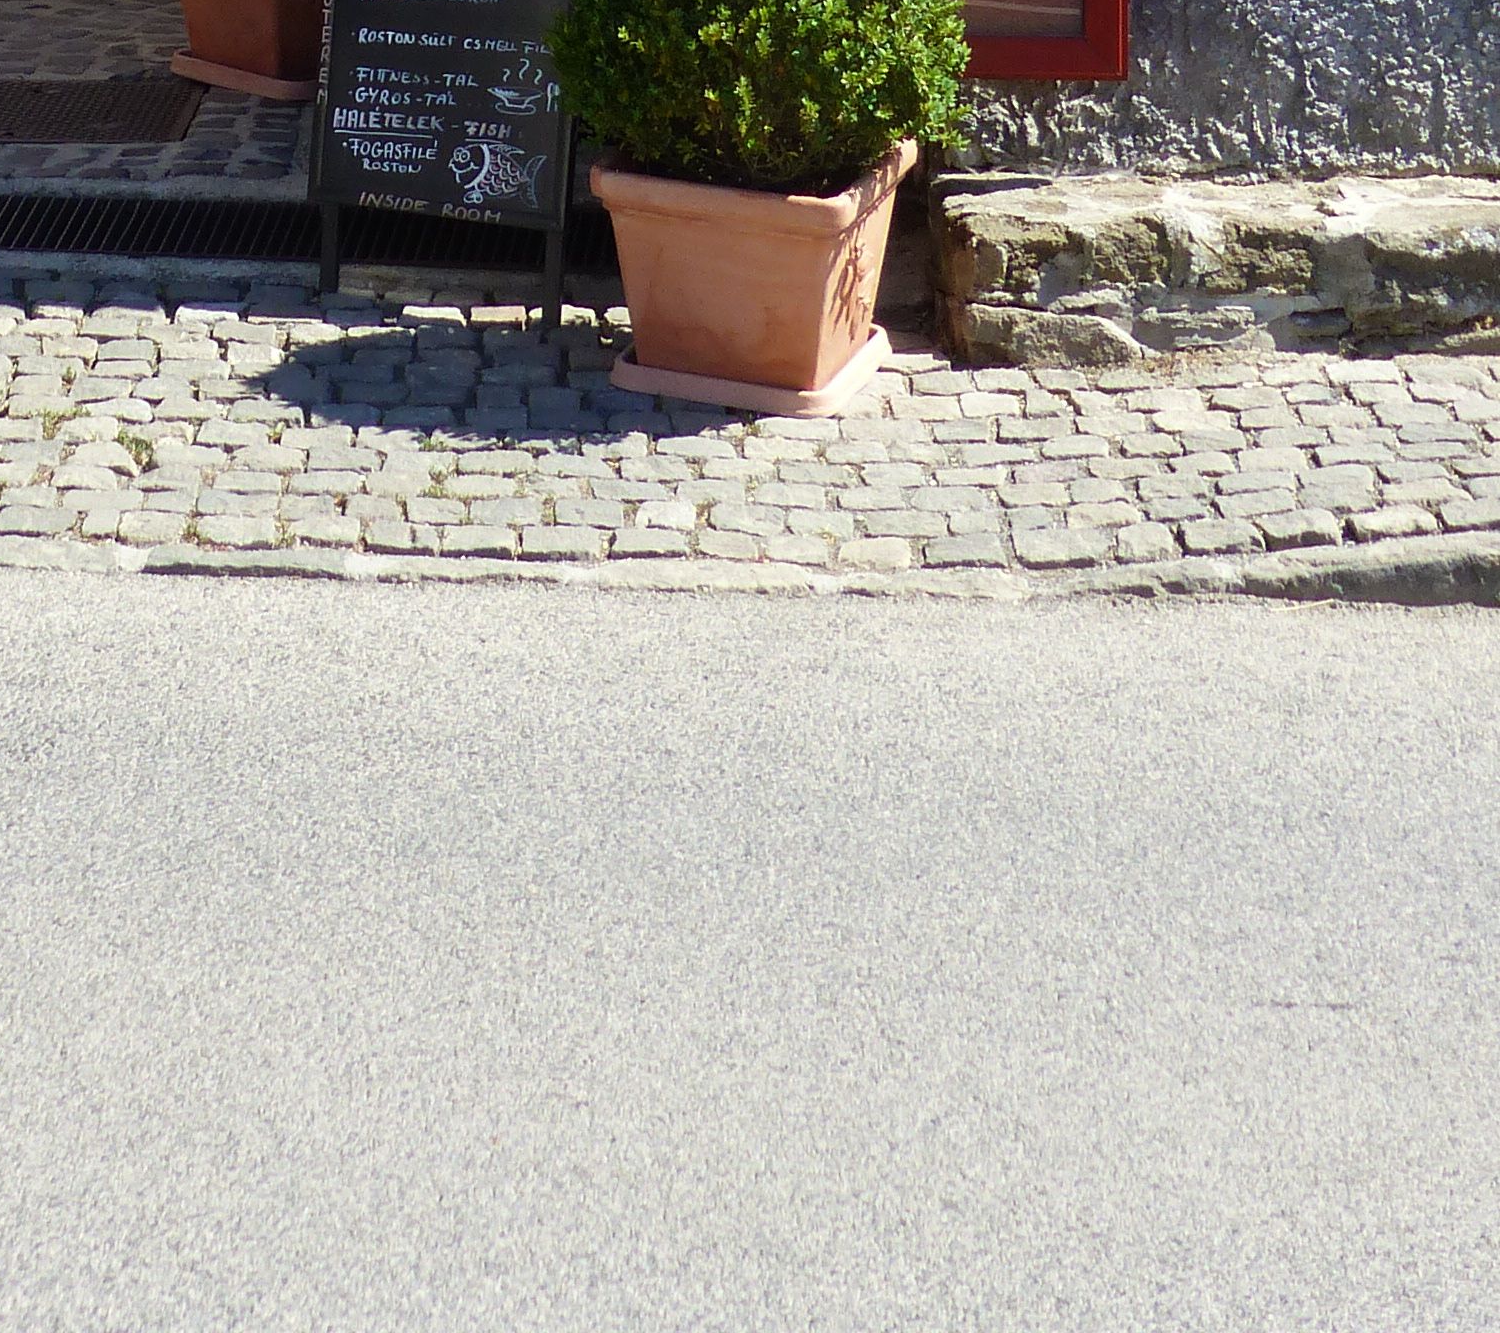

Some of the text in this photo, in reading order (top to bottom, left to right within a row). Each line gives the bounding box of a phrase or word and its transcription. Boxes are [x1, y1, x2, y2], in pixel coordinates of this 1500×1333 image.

[358, 27, 415, 46] ROSTON
[522, 40, 550, 55] FIL
[332, 105, 445, 131] HALÉTELEK
[349, 137, 439, 161] FOGASFILÉ
[362, 159, 422, 174] ROSTON
[358, 191, 502, 222] INSIDE ROOM
